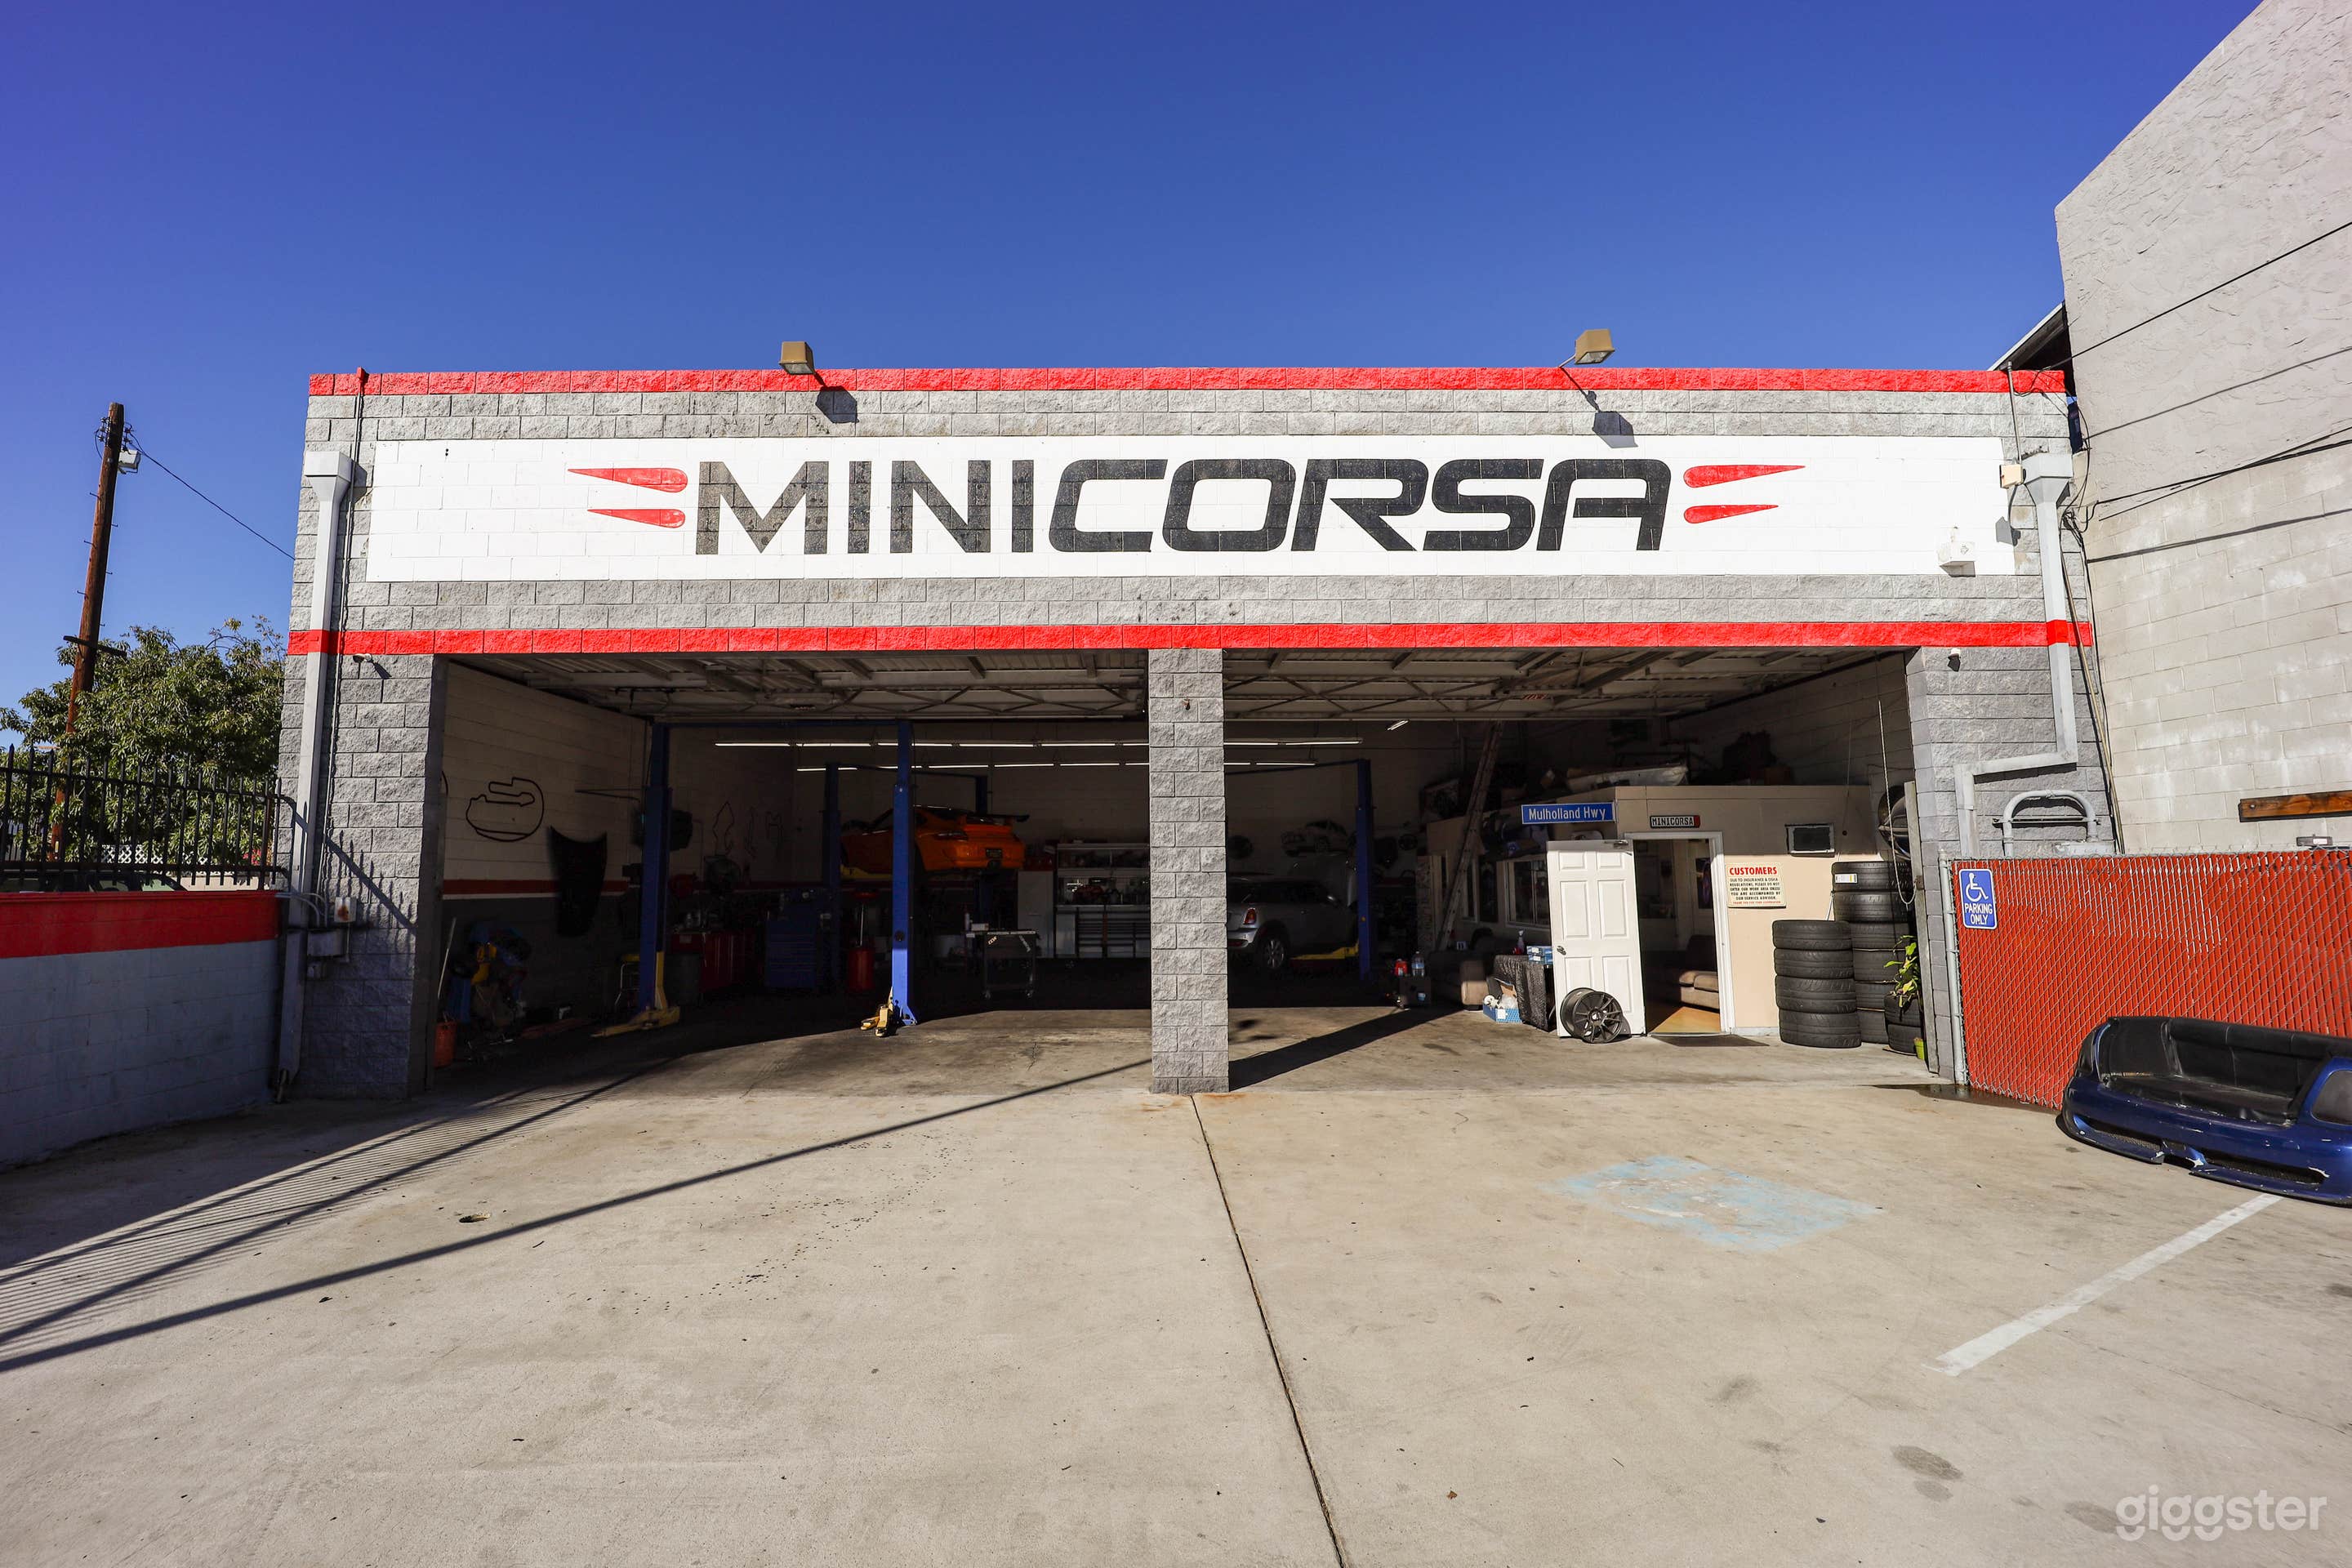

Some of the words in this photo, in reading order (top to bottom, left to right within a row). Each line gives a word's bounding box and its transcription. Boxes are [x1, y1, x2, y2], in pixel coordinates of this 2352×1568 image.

[696, 458, 1671, 555] MINICORSA
[1529, 807, 1580, 820] Mulholland
[1584, 806, 1606, 821] Hwy
[1652, 817, 1694, 826] MINICORSA
[1729, 866, 1777, 875] CUSTOMERS
[1964, 902, 1993, 914] PARKING
[1970, 914, 1989, 924] ONLY
